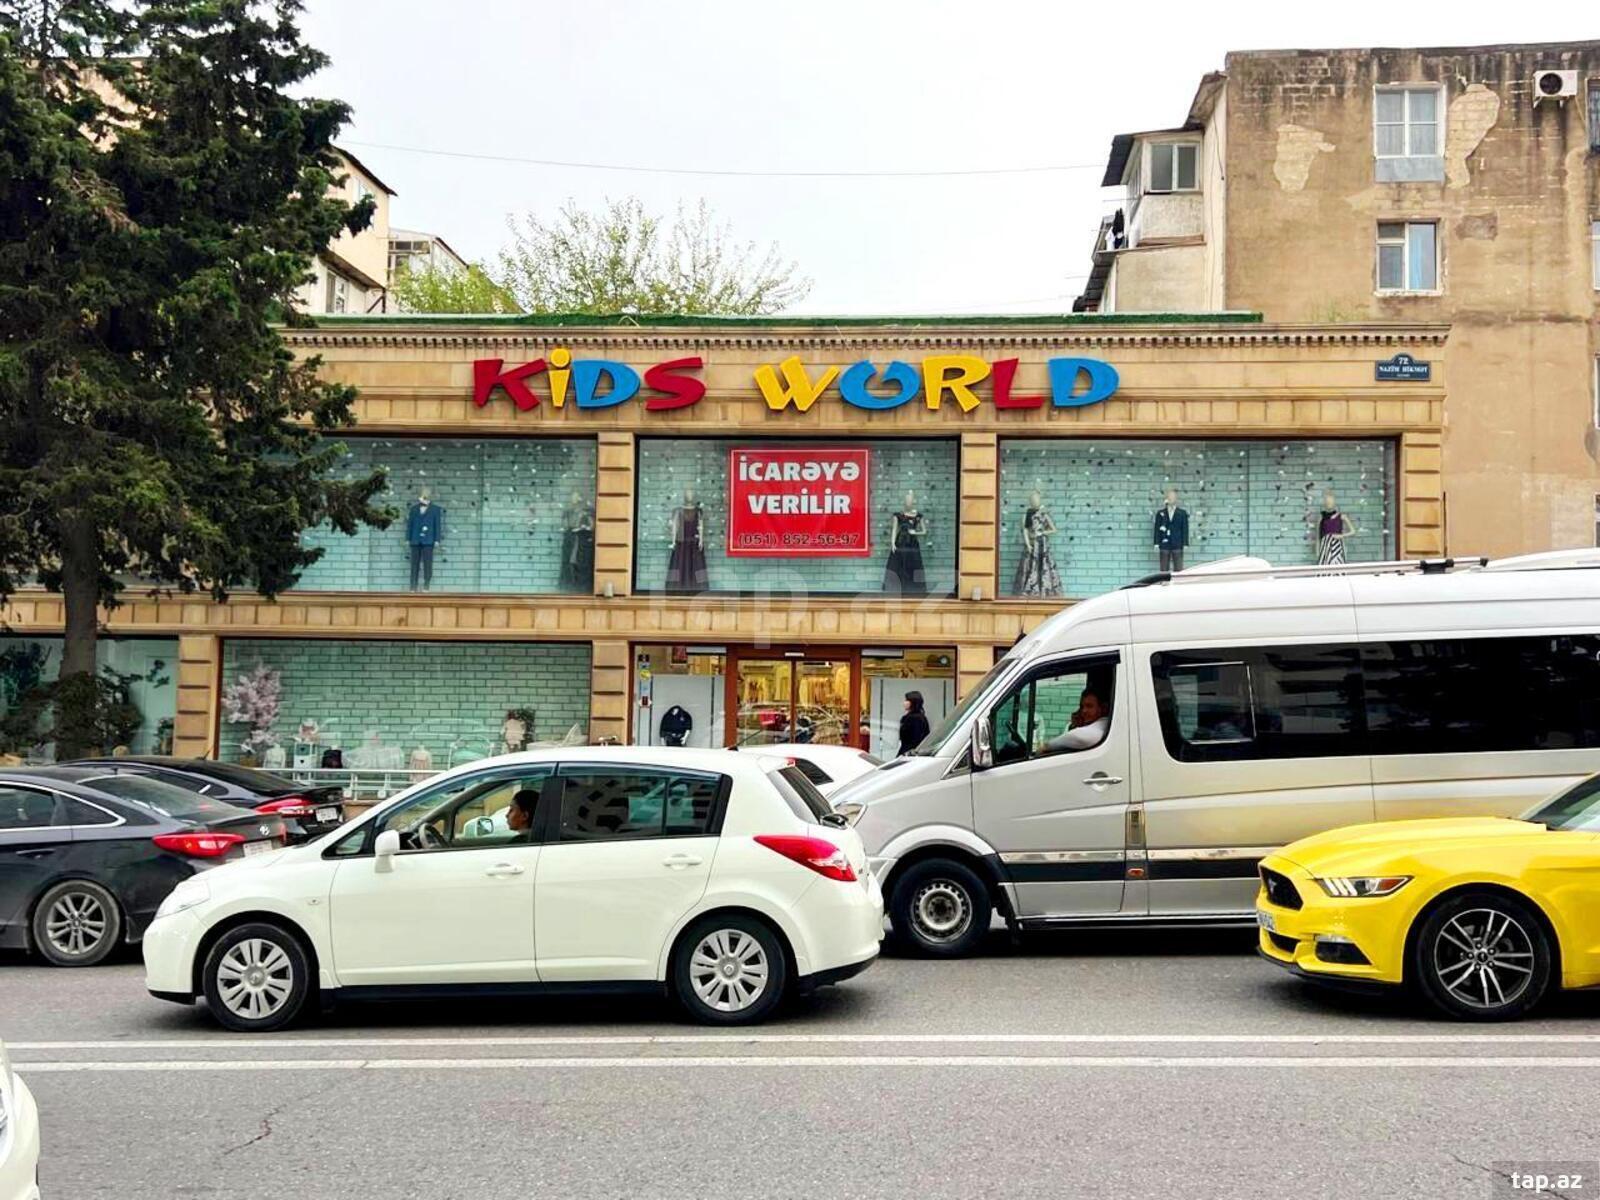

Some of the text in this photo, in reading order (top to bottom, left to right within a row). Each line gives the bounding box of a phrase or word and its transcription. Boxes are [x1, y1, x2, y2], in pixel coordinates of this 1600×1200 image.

[1398, 356, 1409, 365] 72
[753, 356, 1120, 412] WORLD
[739, 455, 860, 481] İCARƏYƏ
[748, 488, 851, 514] VERİLİR
[739, 533, 859, 546] (051) 852-56-97
